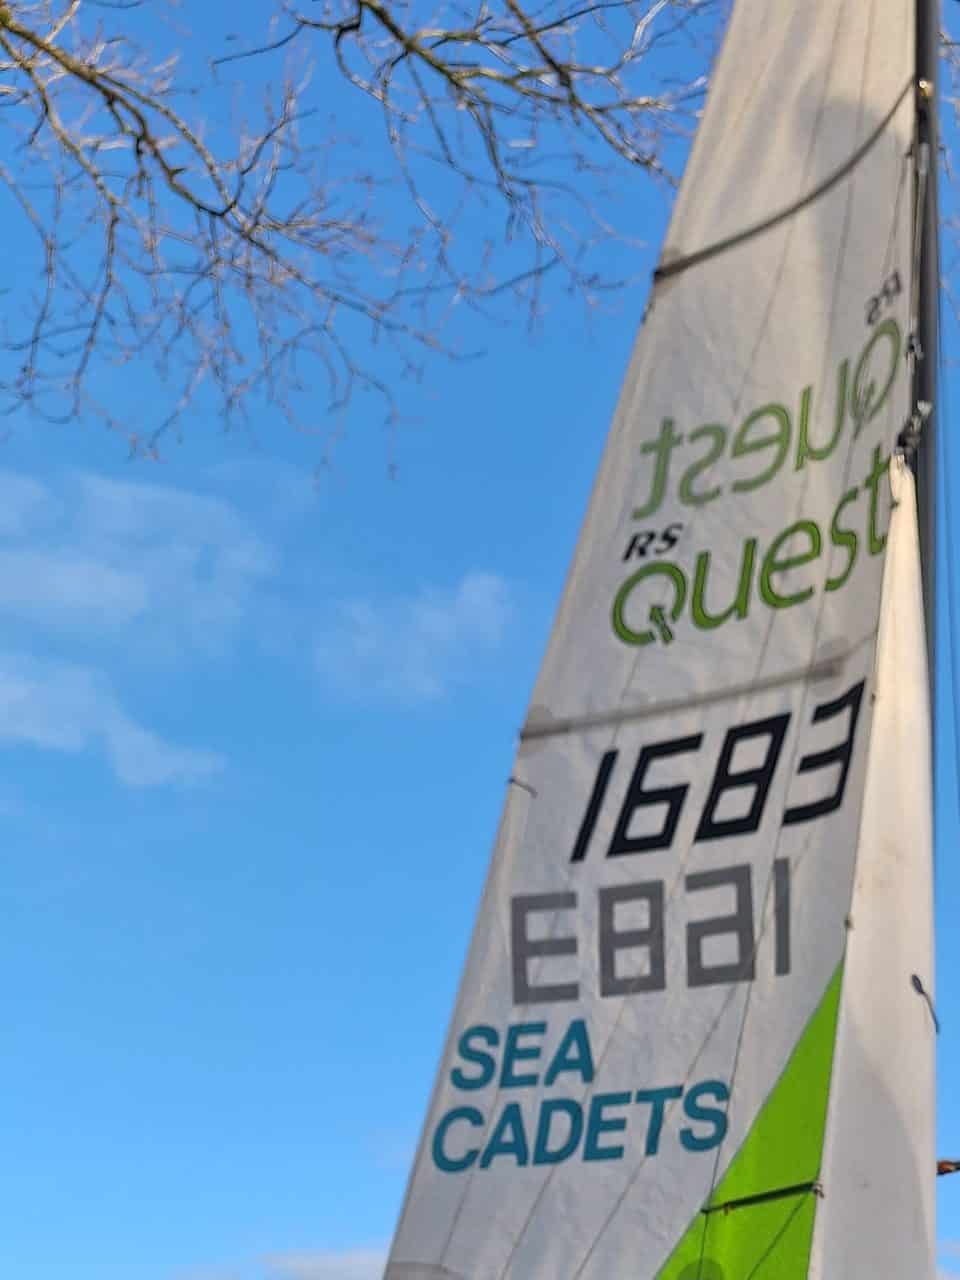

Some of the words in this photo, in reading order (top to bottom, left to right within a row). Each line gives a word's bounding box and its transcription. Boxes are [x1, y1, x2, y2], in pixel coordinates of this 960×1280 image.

[612, 446, 891, 646] Quest
[622, 525, 683, 563] RS
[570, 678, 866, 863] 1683
[450, 1020, 595, 1090] SEA
[431, 1080, 730, 1173] CADETS
